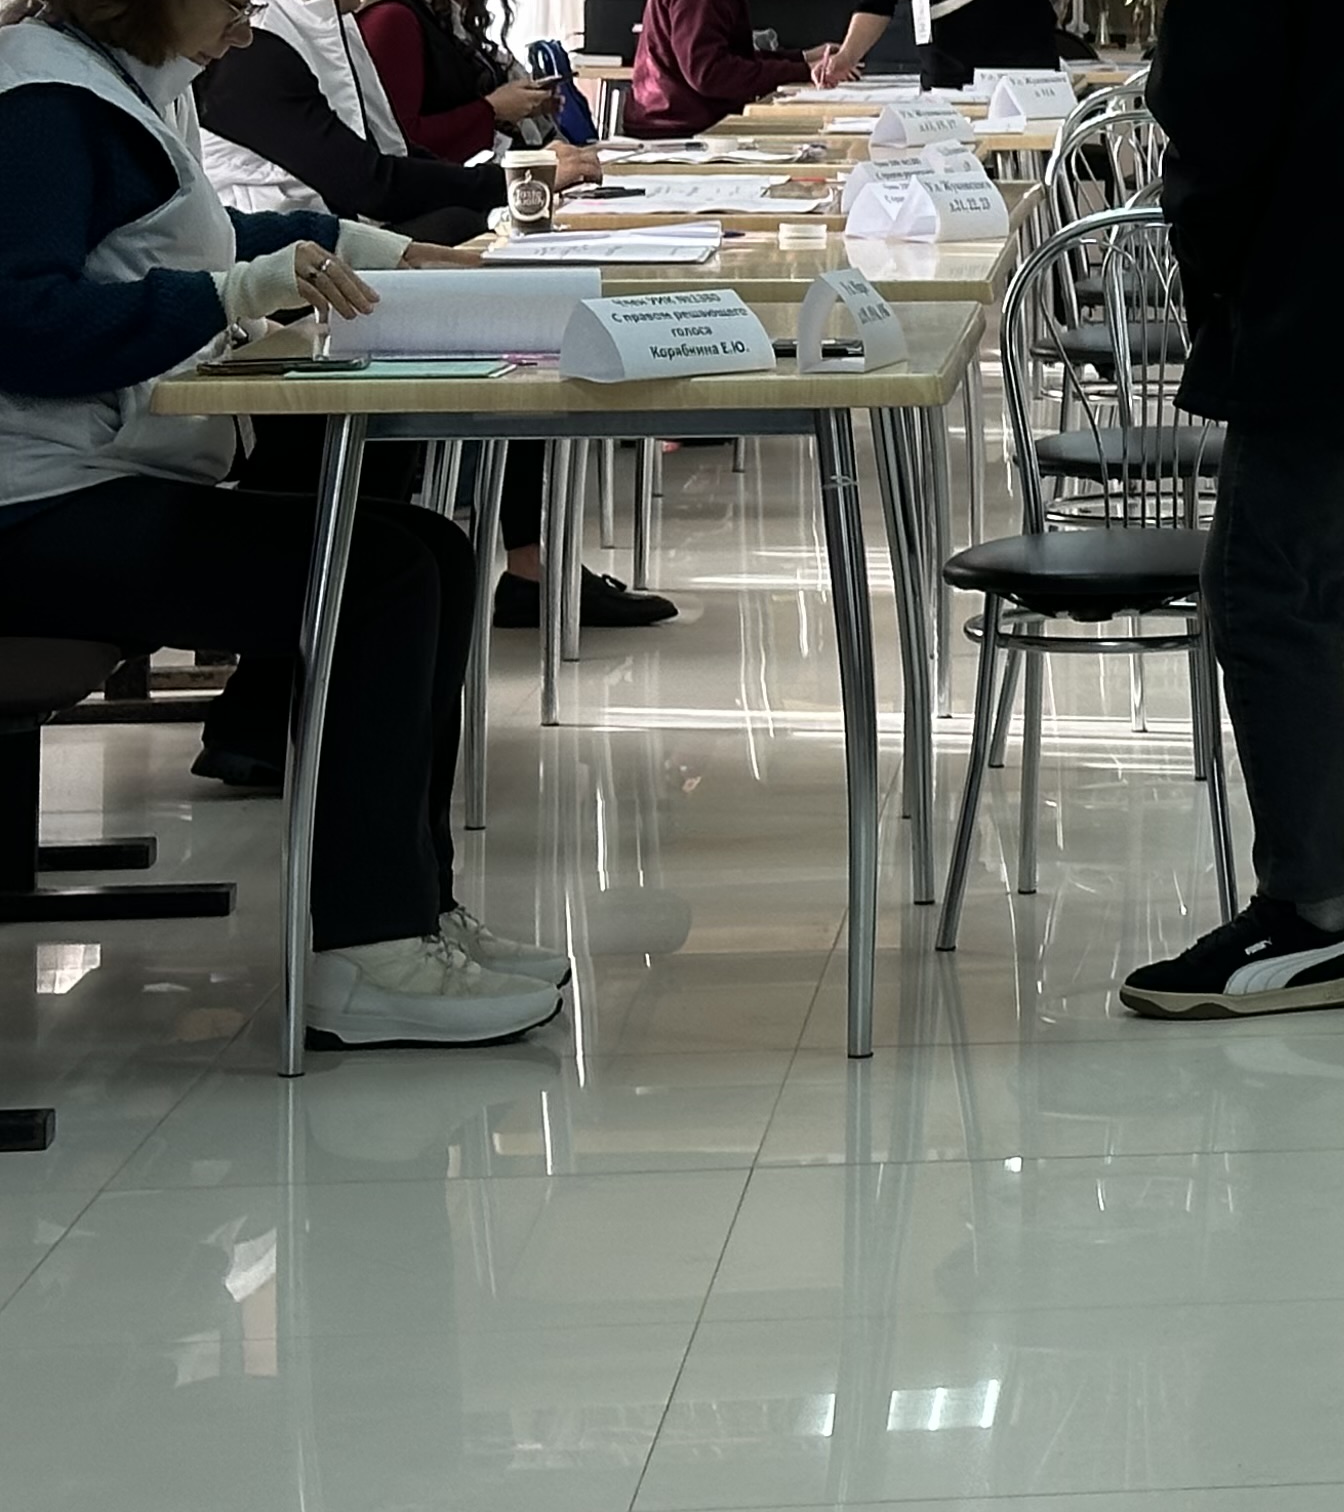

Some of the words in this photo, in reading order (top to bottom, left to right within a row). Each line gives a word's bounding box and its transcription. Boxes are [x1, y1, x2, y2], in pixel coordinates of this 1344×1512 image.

[624, 312, 672, 324] правом
[673, 308, 748, 321] решающего
[671, 326, 712, 337] голоса
